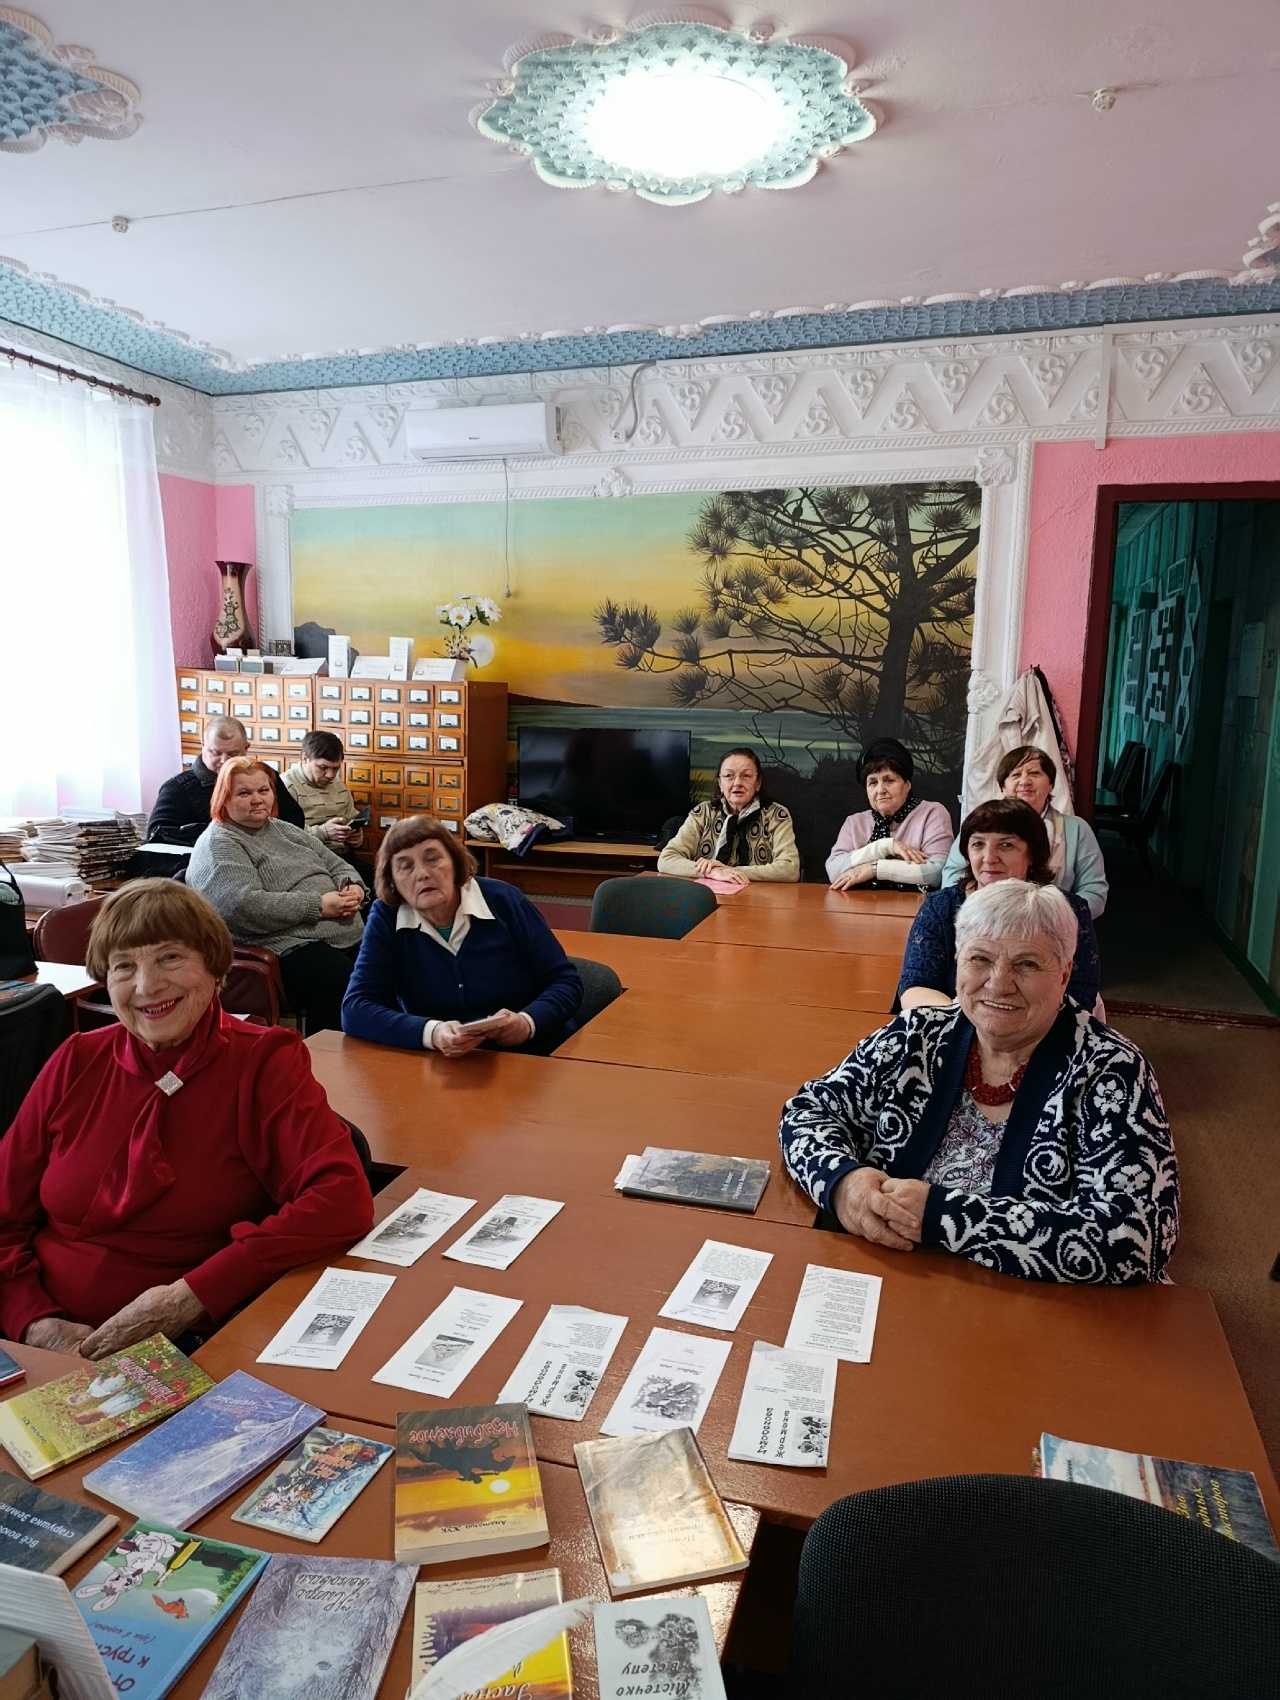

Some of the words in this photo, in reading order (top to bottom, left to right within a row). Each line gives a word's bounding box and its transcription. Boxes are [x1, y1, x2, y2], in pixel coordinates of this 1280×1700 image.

[409, 1417, 519, 1446] Незабываемое
[1176, 1494, 1191, 1519] Зов
[1192, 1485, 1212, 1528] одных
[1210, 1479, 1241, 1543] росторов
[30, 1516, 75, 1539] старушка
[19, 1535, 40, 1548] Всё
[295, 1574, 371, 1595] вековая
[295, 1588, 352, 1612] Нить
[136, 1655, 151, 1669] к
[621, 1661, 668, 1675] степу
[671, 1661, 681, 1671] в
[112, 1673, 136, 1692] От
[615, 1681, 691, 1697] Містечко
